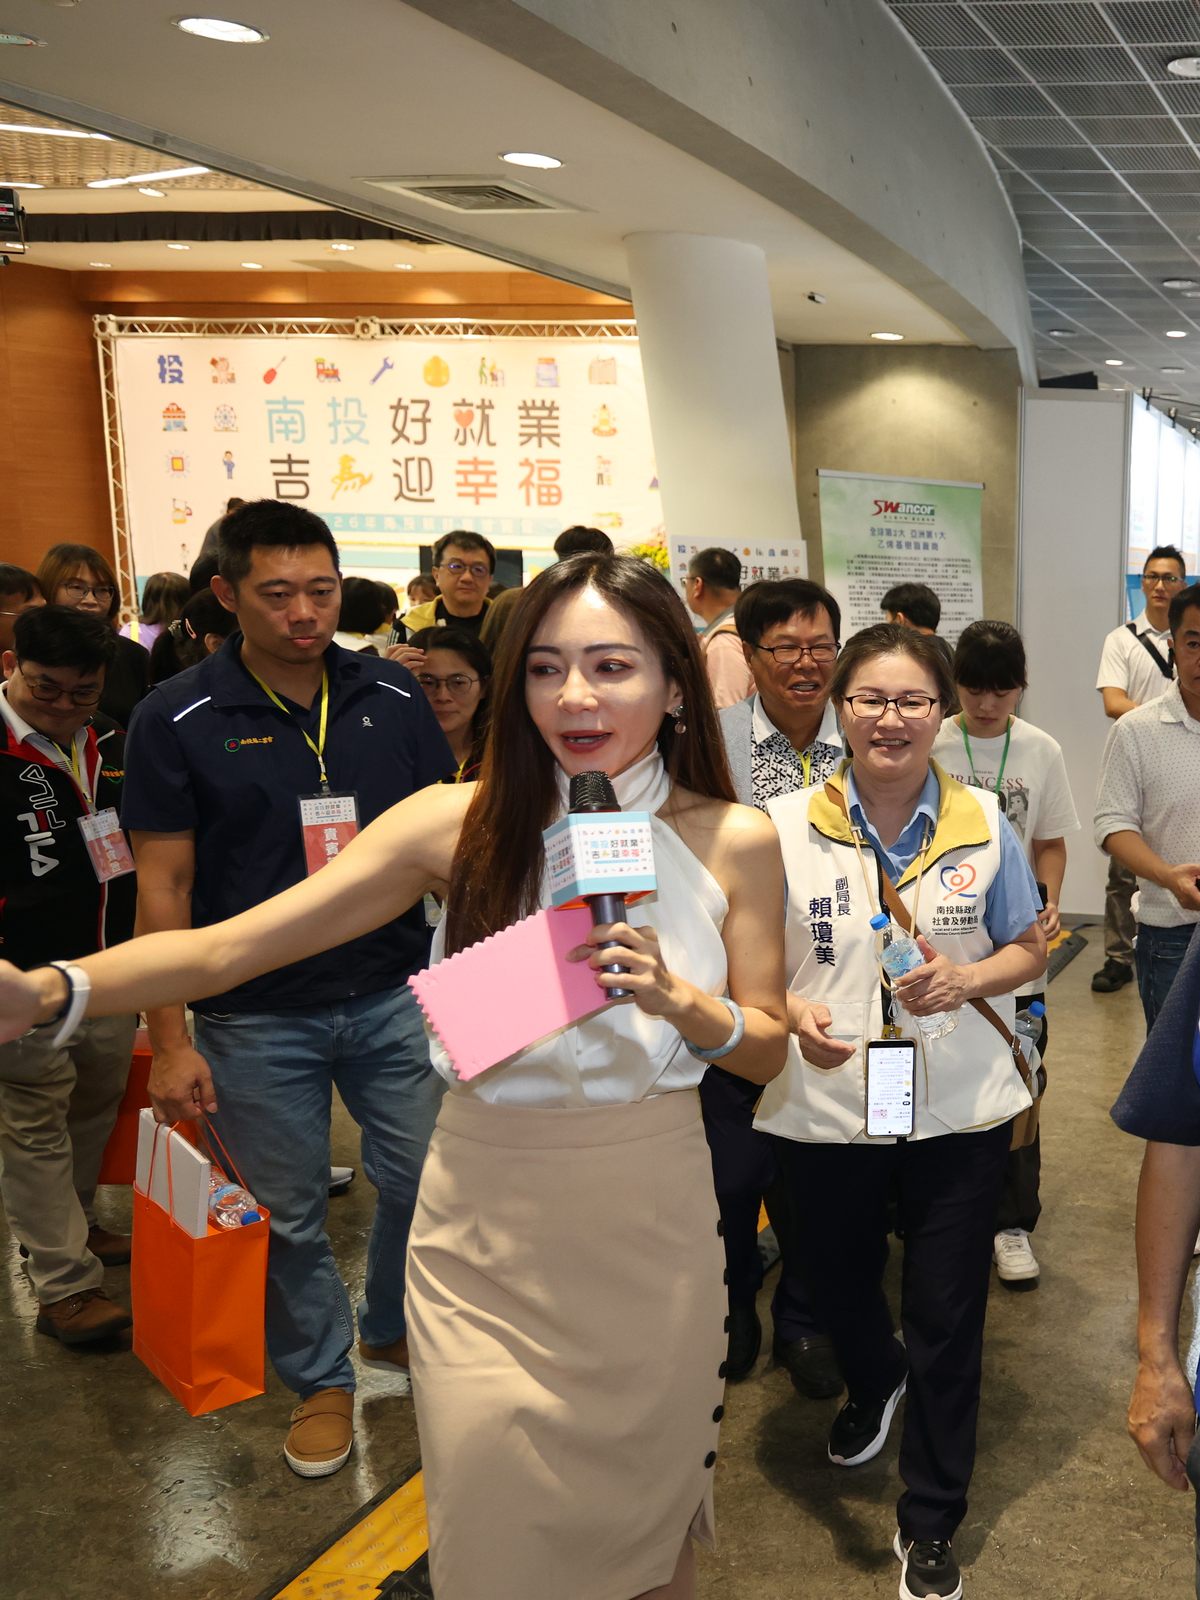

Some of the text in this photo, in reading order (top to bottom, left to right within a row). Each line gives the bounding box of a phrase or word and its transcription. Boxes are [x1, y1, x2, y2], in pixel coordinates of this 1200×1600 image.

[264, 396, 561, 448] 南投好就業
[835, 876, 851, 917] 副局長
[809, 897, 836, 966] 賴瓊美
